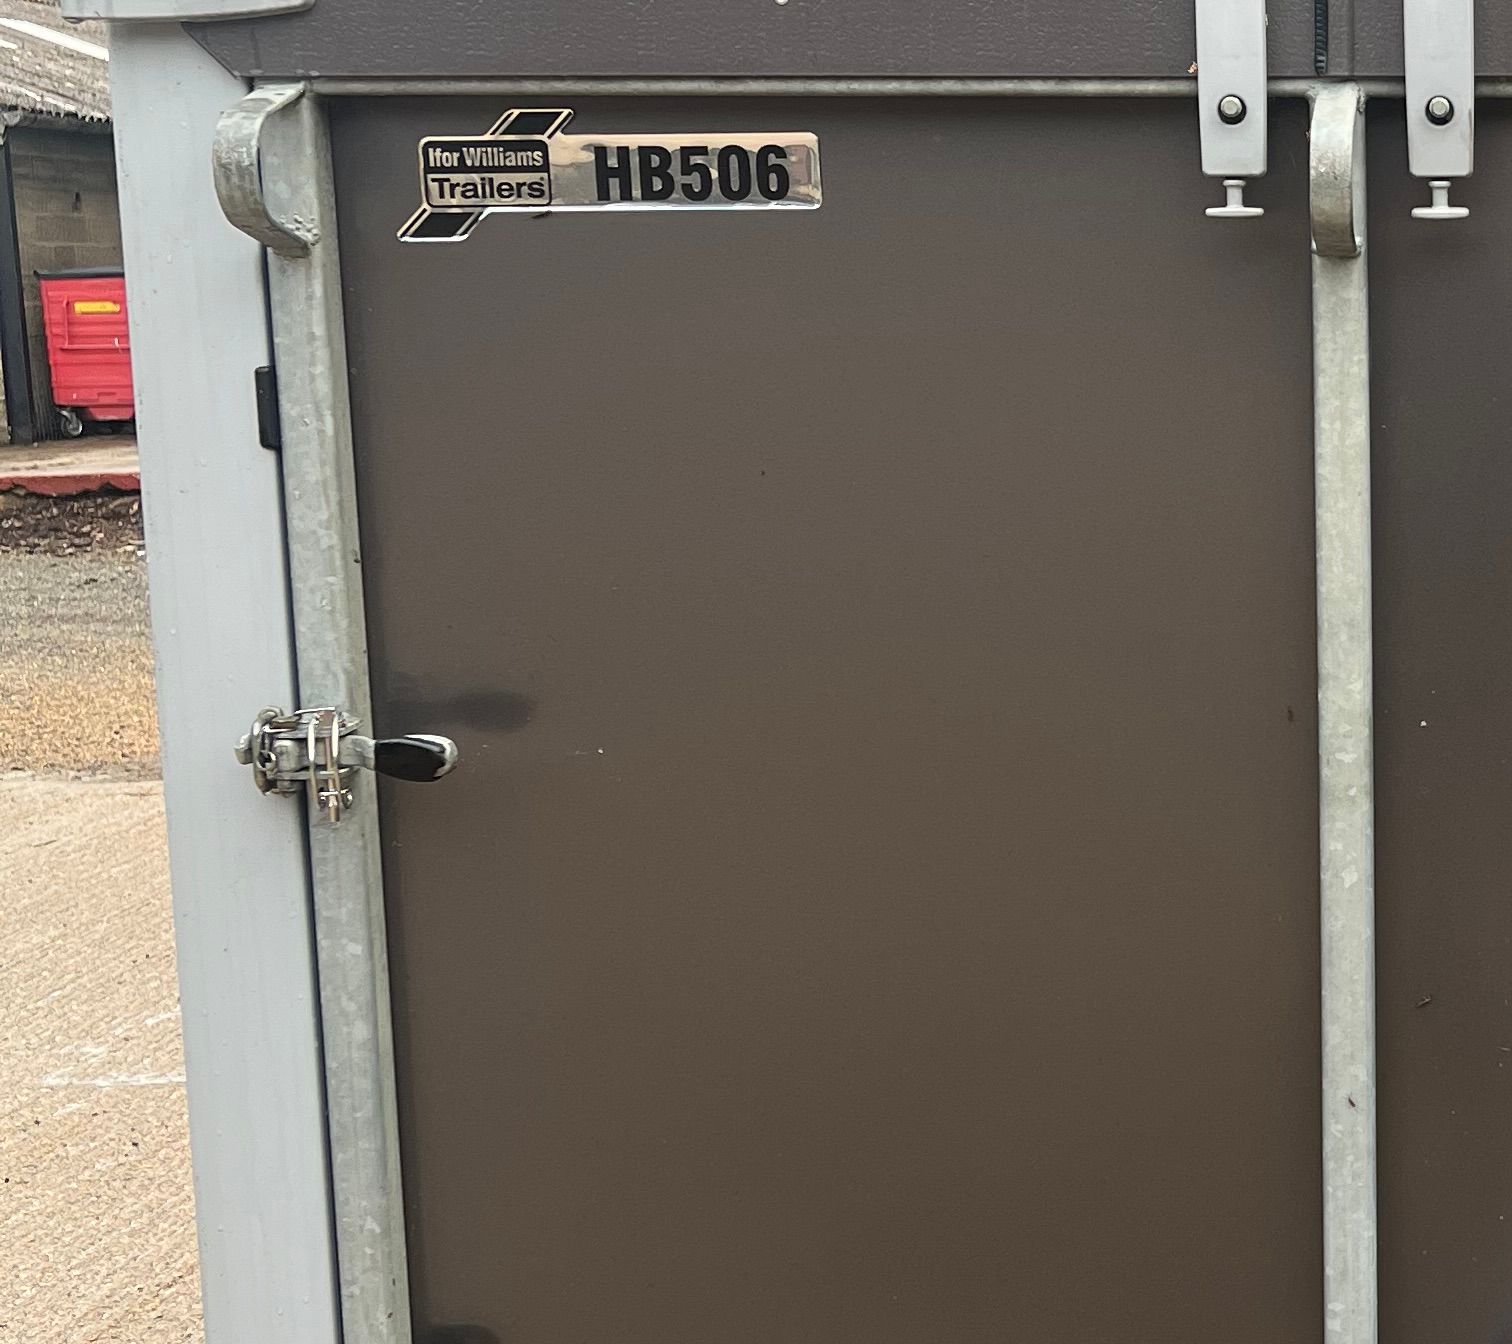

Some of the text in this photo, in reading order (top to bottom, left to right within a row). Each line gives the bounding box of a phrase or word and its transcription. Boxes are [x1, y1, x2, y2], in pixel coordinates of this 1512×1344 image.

[428, 146, 544, 168] Ifor Williams
[594, 144, 790, 202] HB506
[430, 177, 545, 199] Trailers
